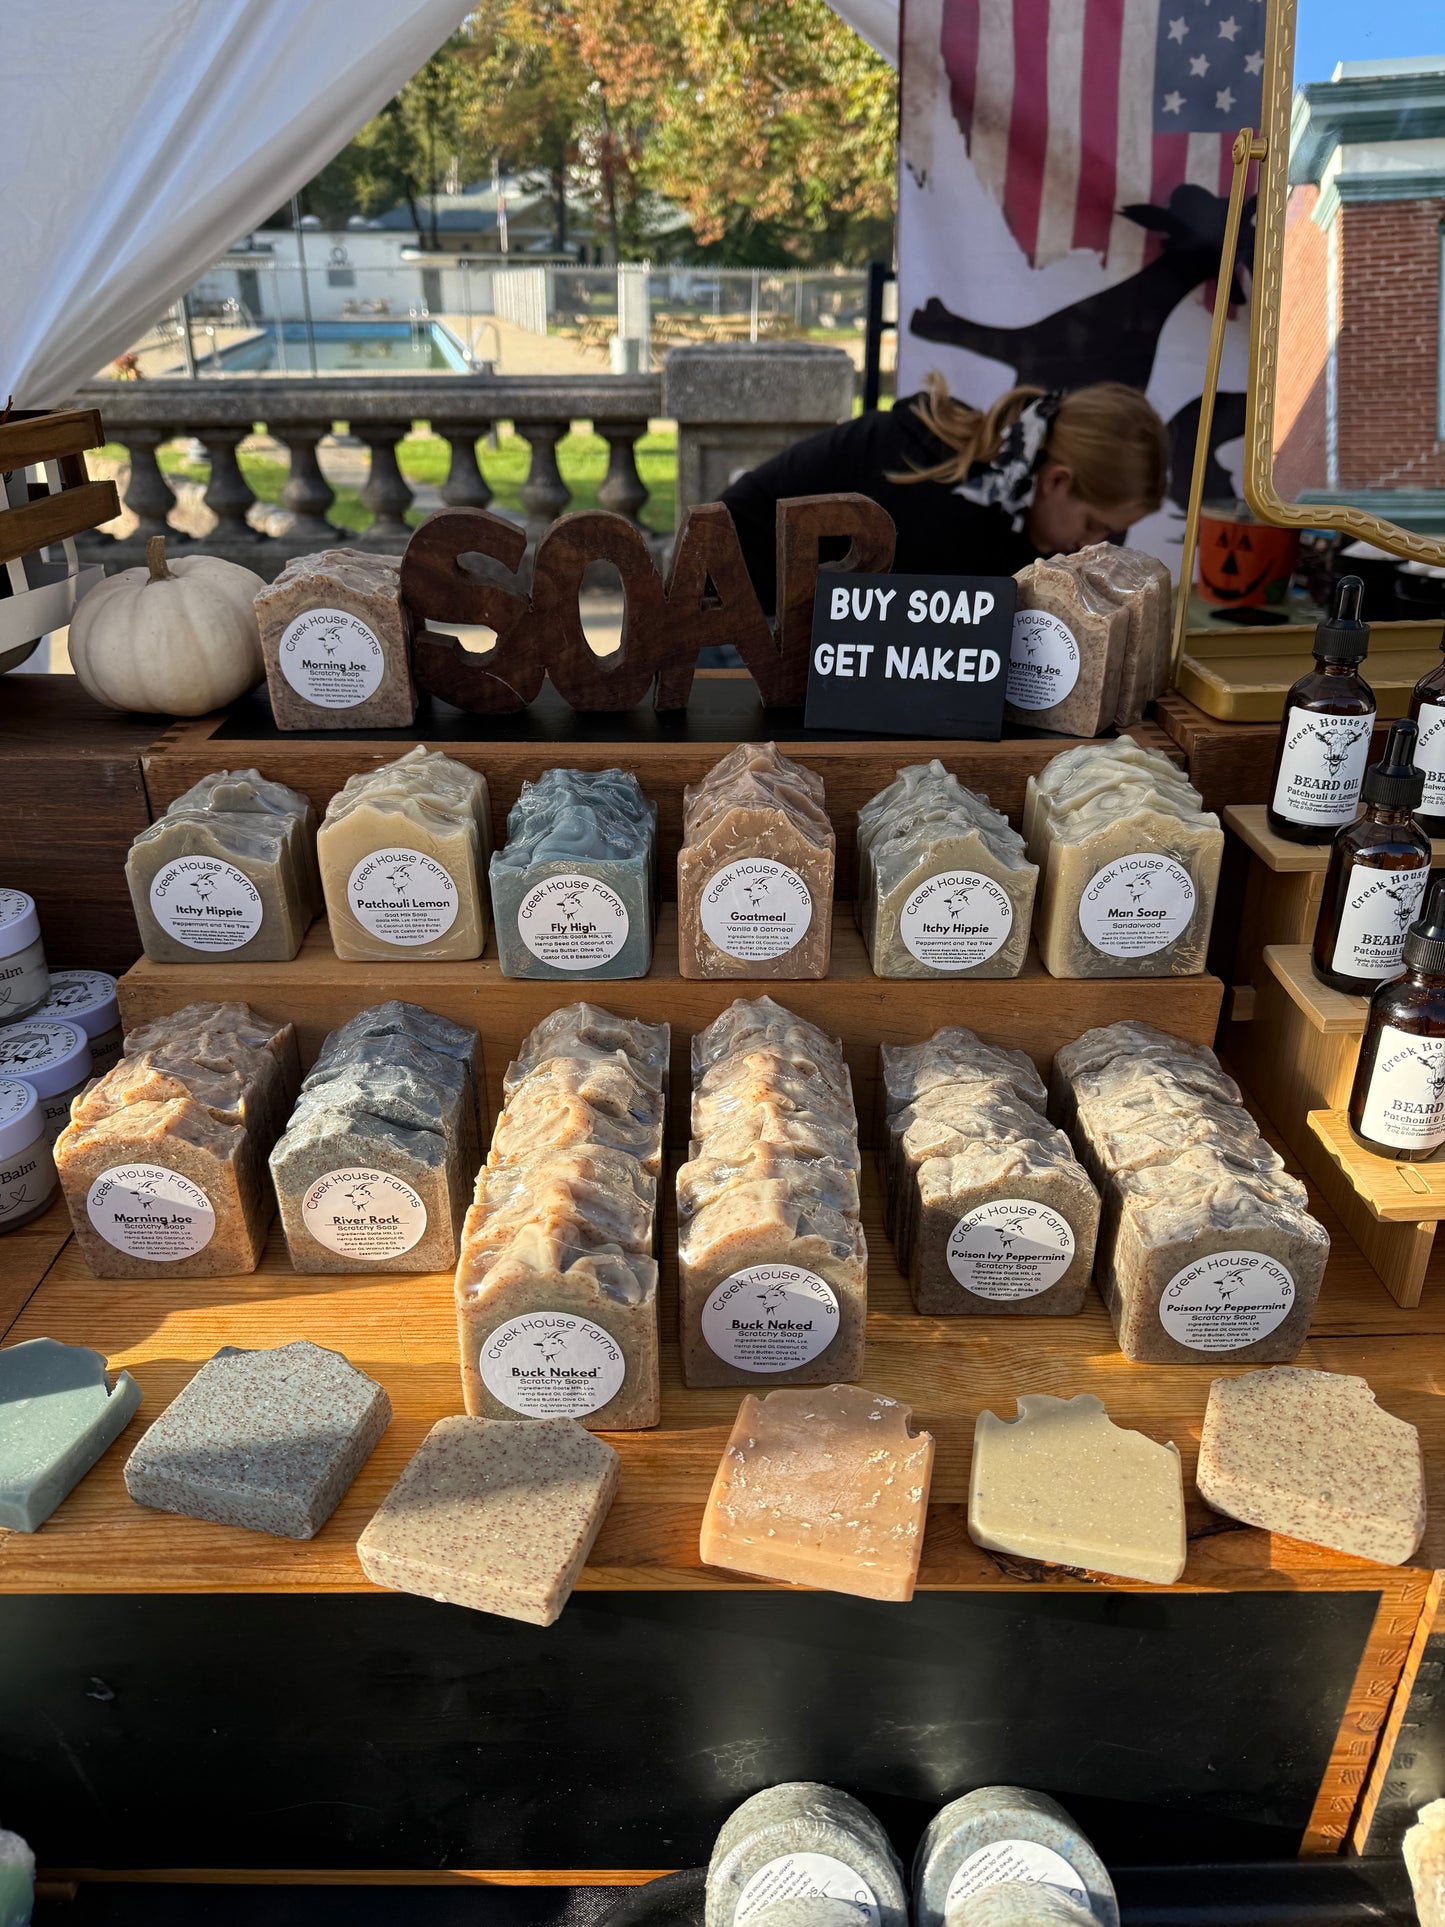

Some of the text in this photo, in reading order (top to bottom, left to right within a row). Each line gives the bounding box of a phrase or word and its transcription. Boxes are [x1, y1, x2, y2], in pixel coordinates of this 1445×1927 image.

[400, 492, 898, 714] SOAP
[830, 586, 996, 626] BUY SOAP
[285, 615, 381, 656] Creek House Farms
[1016, 616, 1077, 661] House Farms
[302, 659, 367, 673] Morning Joe
[814, 644, 1002, 683] GET NAKED
[1044, 664, 1061, 675] Joe
[1287, 717, 1360, 750] Creek House
[1293, 774, 1341, 791] BEARD
[1287, 786, 1329, 801] Patchouli
[1330, 793, 1336, 801] &
[353, 854, 453, 891] Creek House Farms
[1087, 860, 1193, 901] Creek House Farms
[155, 861, 259, 902] Creek House Farms
[708, 865, 811, 906] Creek House Farms
[906, 877, 1010, 916] Creek House Farms
[1351, 870, 1427, 910] Creek House
[357, 898, 450, 909] Patchouli Lemon
[521, 880, 624, 919] Creek House Farms
[175, 904, 243, 918] Itchy Hippie
[730, 911, 786, 922] Goatmeal
[1108, 907, 1167, 919] Man Soap
[551, 922, 597, 935] Fly High
[922, 923, 989, 935] Itchy Hippie
[1353, 945, 1398, 957] Patchouli
[0, 966, 24, 980] alm
[24, 1024, 63, 1032] HOUSE
[1381, 1046, 1418, 1073] Creek
[1391, 1099, 1444, 1115] BEARD
[1383, 1110, 1432, 1124] Patchouli
[0, 1160, 37, 1185] Balm
[92, 1169, 208, 1209] Creek House Farms
[306, 1172, 421, 1210] Creek House Farms
[114, 1213, 193, 1226] Morning Joe
[332, 1215, 400, 1225] River Rock
[952, 1205, 1070, 1247] Creek House Farms
[951, 1250, 1066, 1262] Poison Ivy Peppermint
[975, 1262, 1014, 1270] Scratchy
[1168, 1257, 1292, 1298] Creek House Farms
[712, 1270, 836, 1315] Creek House Farms
[1166, 1302, 1287, 1313] Poison Ivy Peppermint
[731, 1320, 813, 1330] Buck Naked
[488, 1318, 620, 1361] Creek House Farms
[738, 1330, 804, 1339] Scratchy Soap
[511, 1367, 597, 1378] Buck Naked
[519, 1378, 589, 1386] Scratchy Soap
